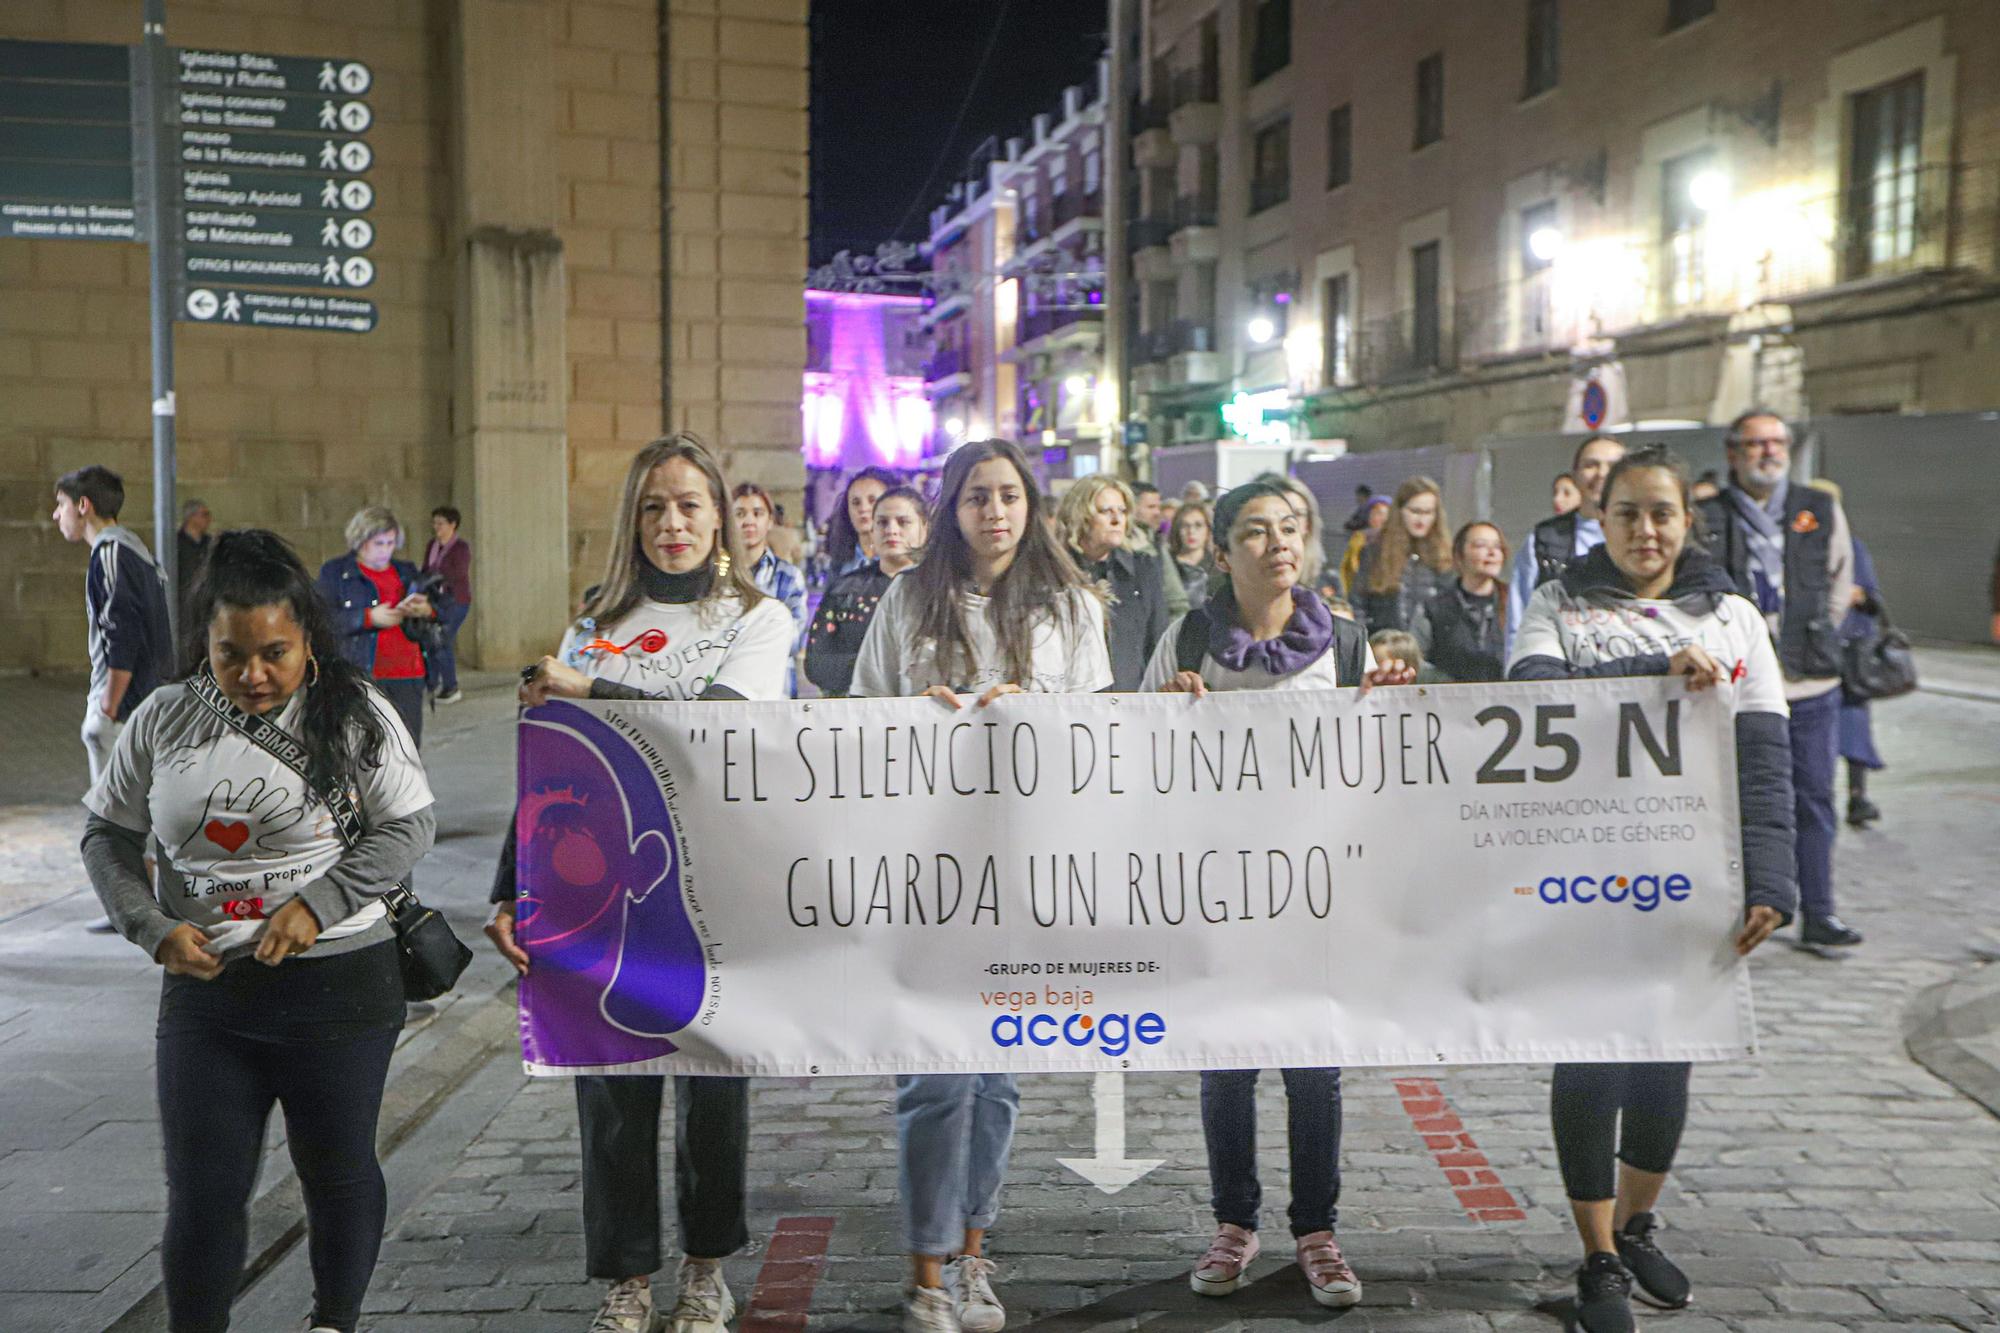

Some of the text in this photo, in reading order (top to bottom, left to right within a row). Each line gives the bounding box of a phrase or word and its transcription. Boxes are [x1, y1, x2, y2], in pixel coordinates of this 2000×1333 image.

[182, 145, 203, 161] de
[220, 147, 306, 167] Reconquista
[184, 186, 247, 206] Santiago
[186, 211, 256, 227] santuario
[186, 226, 293, 247] de Monserrate
[187, 257, 321, 276] OTROS MONUMENTOS
[209, 689, 250, 728] LOLA
[253, 723, 309, 772] BIMBA
[1474, 699, 1683, 784] 25 N
[795, 722, 1039, 802] SILENCIO
[1070, 723, 1125, 795] DE
[1151, 727, 1263, 794] UNA
[1289, 712, 1451, 794] MUJER
[1459, 795, 1708, 821] DÍA INTERNACIONAL CONTRA
[1474, 821, 1696, 848] LA VIOLENCIA DE GÉNERO
[205, 879, 252, 896] amor
[787, 852, 1001, 927] GUARDA
[1030, 851, 1097, 927] UN
[1538, 873, 1692, 912] acoge
[1046, 962, 1065, 975] DE
[1069, 962, 1133, 976] MUJERES
[980, 984, 1094, 1012] vega baja
[991, 1012, 1167, 1057] acoge
